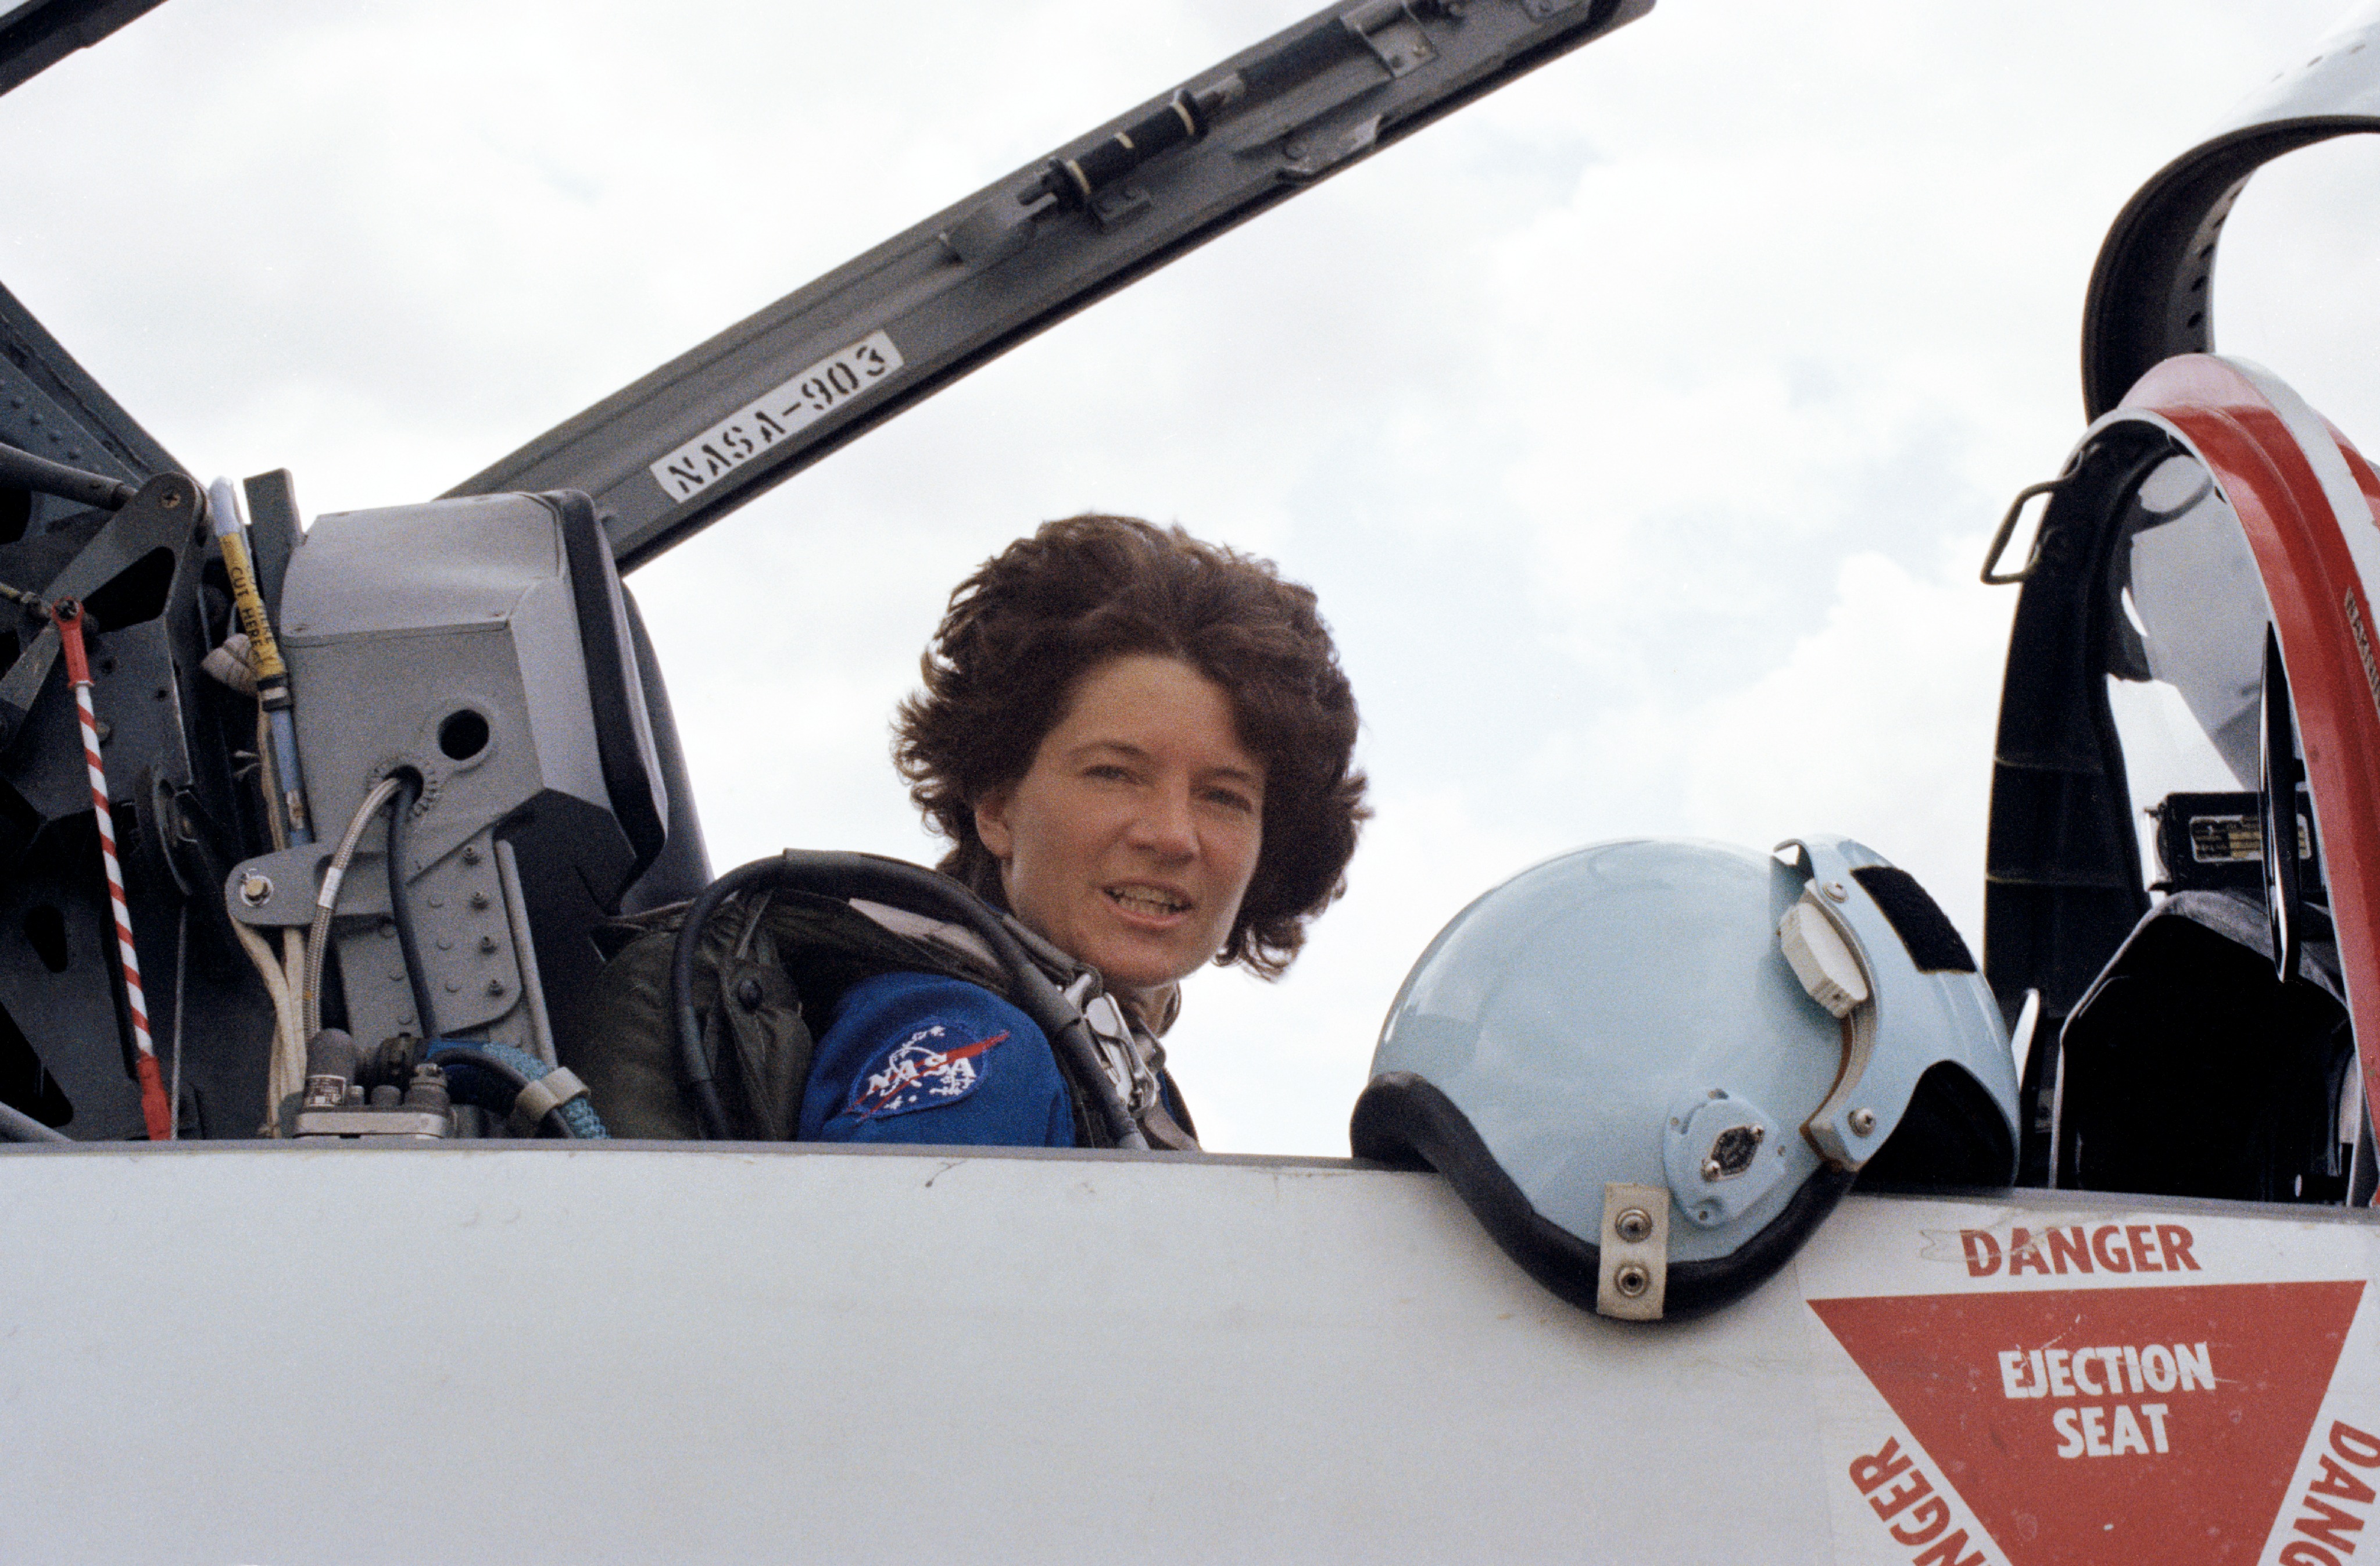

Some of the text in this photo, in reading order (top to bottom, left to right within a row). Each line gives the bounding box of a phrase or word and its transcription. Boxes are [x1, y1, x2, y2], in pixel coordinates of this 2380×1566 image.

[667, 345, 889, 494] NASA-903
[230, 566, 249, 597] CUT
[242, 607, 262, 647] HERE
[867, 1053, 977, 1095] NASA
[1959, 1224, 2202, 1278] DANGER
[1998, 1342, 2216, 1399] EJECTION
[2053, 1403, 2169, 1458] SEAT
